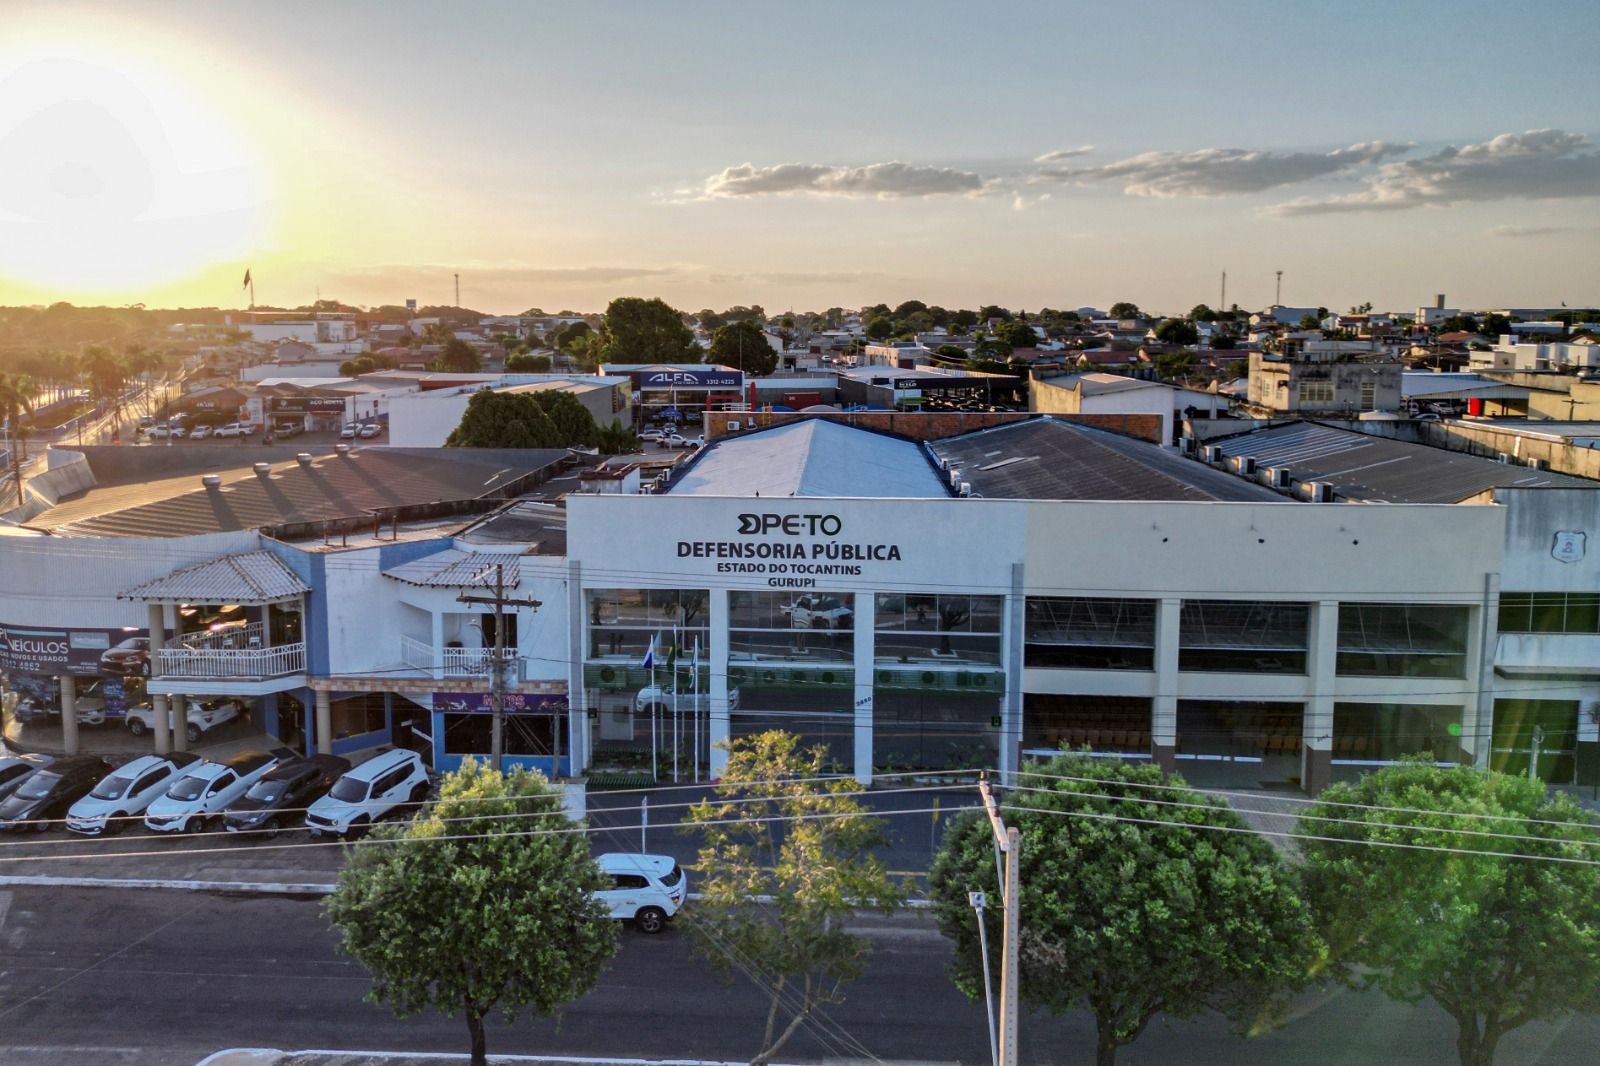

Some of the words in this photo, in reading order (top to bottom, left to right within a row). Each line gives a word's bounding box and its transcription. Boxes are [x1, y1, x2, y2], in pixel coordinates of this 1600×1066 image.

[648, 373, 699, 382] ALFA
[677, 541, 807, 560] DEFENSORIA
[812, 541, 902, 561] PÚBLICA
[717, 562, 766, 573] ESTADO
[769, 563, 787, 574] DO
[790, 563, 862, 576] TOCANTINS
[767, 577, 816, 588] GURUPI
